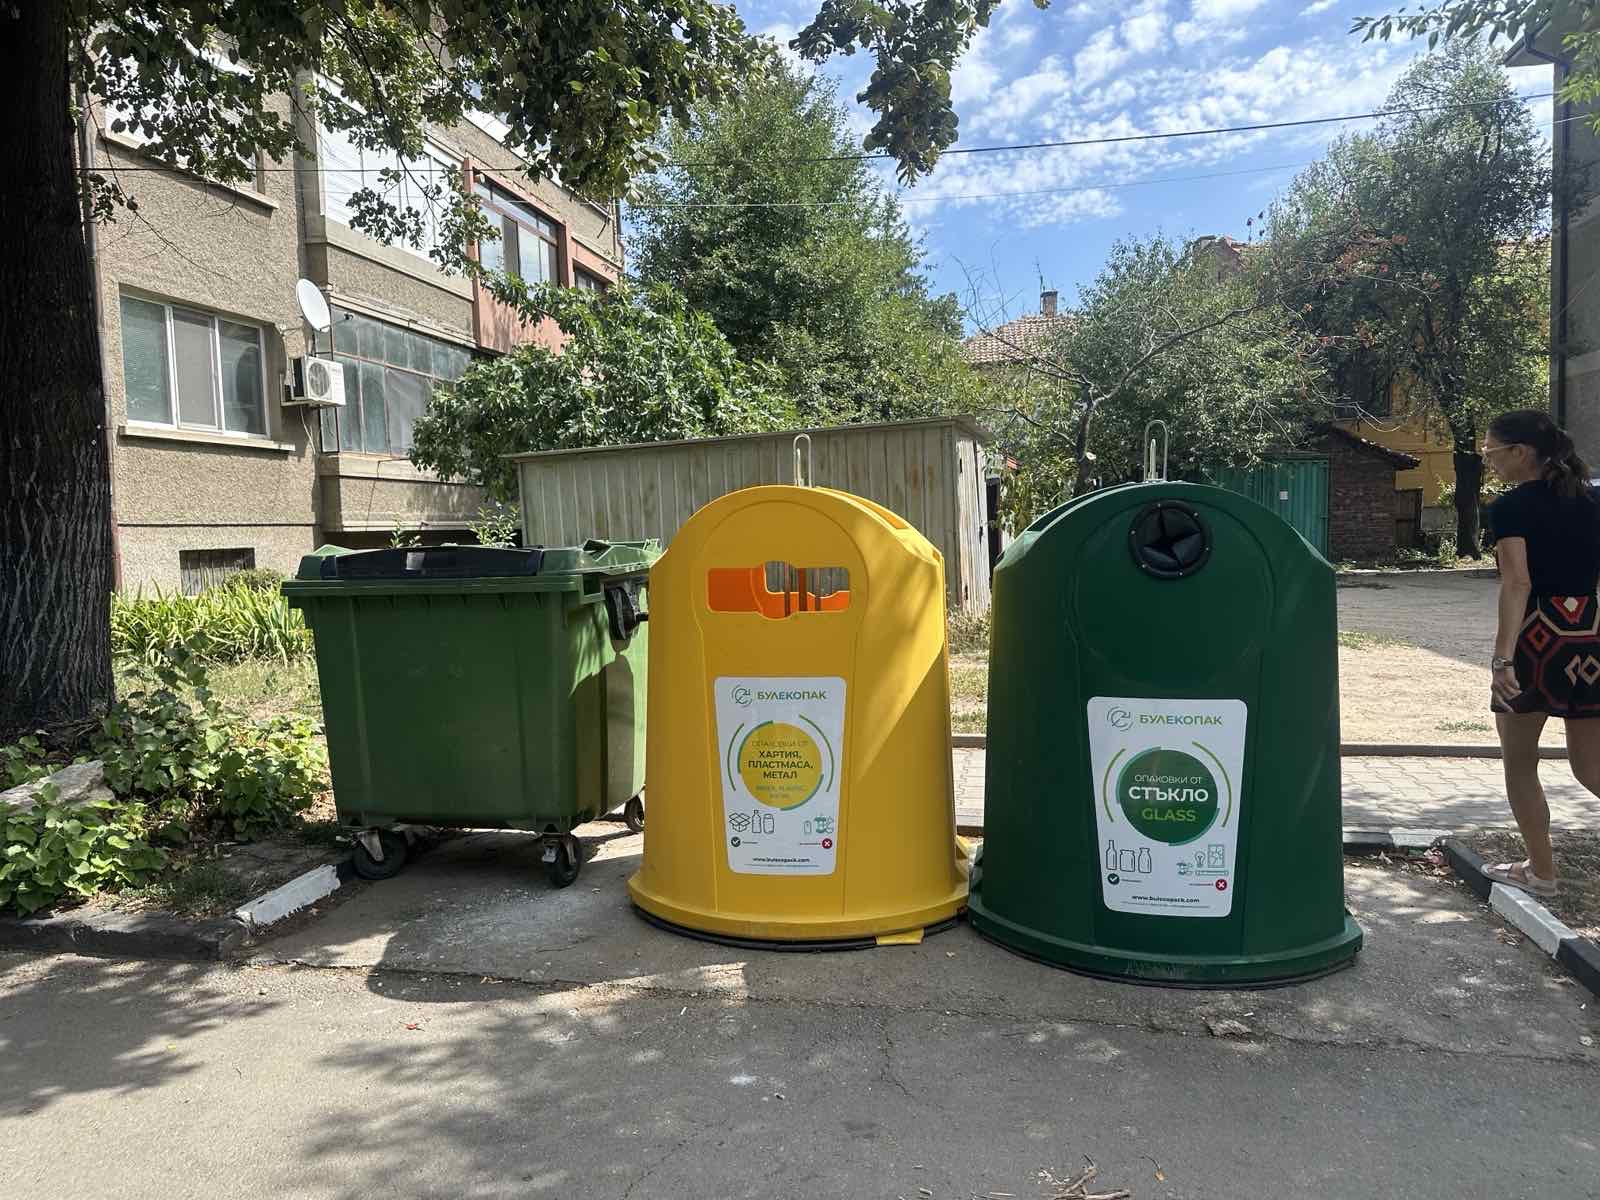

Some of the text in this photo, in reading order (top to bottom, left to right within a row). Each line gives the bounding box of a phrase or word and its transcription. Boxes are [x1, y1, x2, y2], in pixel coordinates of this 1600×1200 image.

[757, 690, 827, 700] БУЛЕКОПАК
[1139, 714, 1223, 725] БУЛЕКОПАК
[759, 750, 802, 760] ХАРТИЯ,
[763, 771, 797, 779] МЕТАЛ
[1134, 774, 1201, 785] ОПАКОВКИ ОТ
[1128, 786, 1208, 802] СТЪКЛО
[1142, 808, 1196, 822] GLASS
